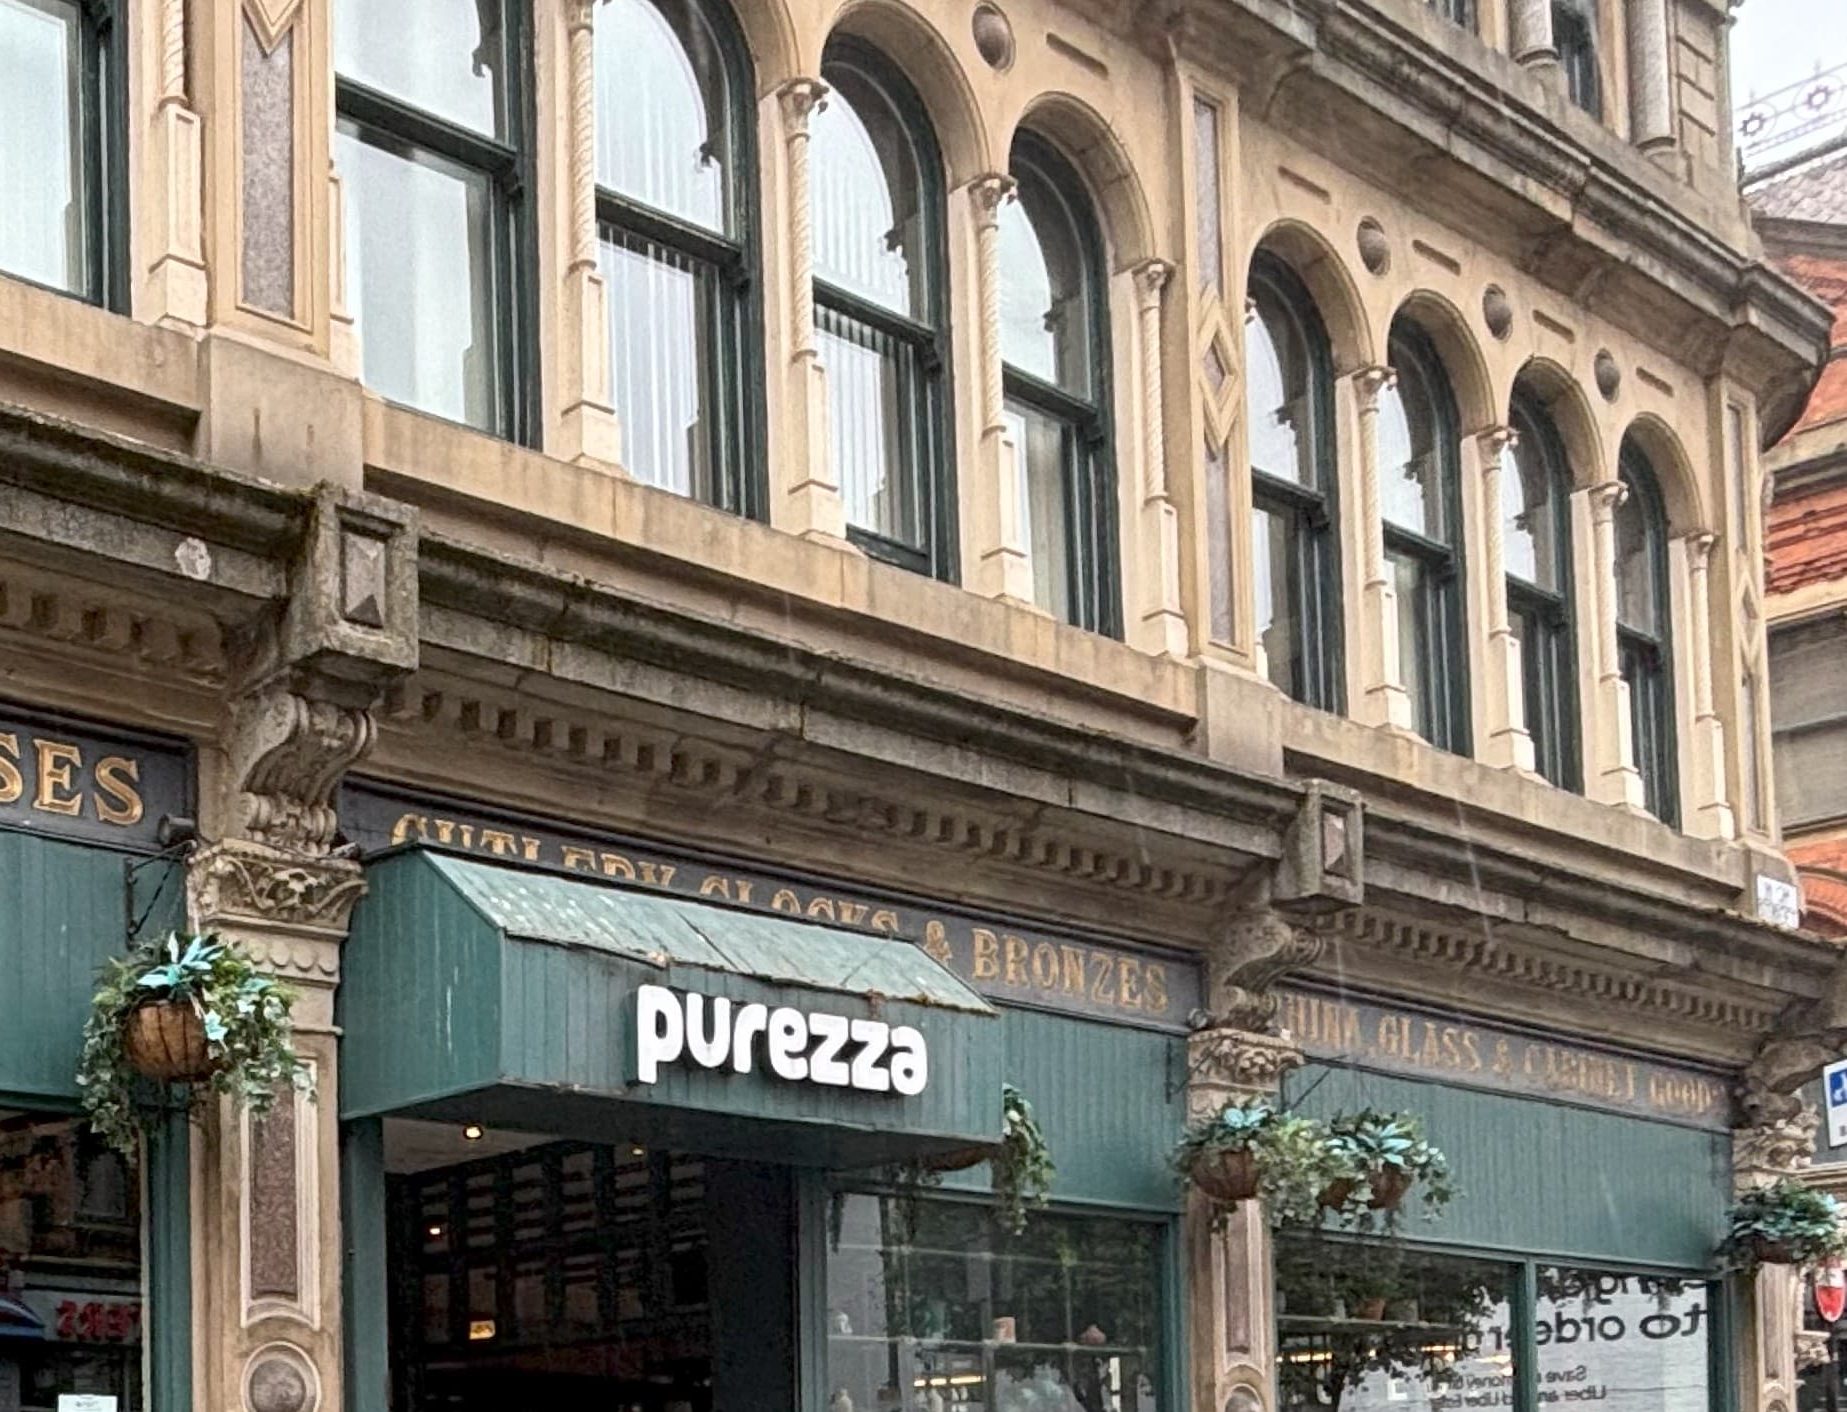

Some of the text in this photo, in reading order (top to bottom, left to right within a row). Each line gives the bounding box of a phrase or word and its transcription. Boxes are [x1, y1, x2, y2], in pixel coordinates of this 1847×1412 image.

[972, 927, 1169, 1012] BRONZES
[635, 984, 929, 1095] purezza
[1378, 1014, 1482, 1073] GLASS
